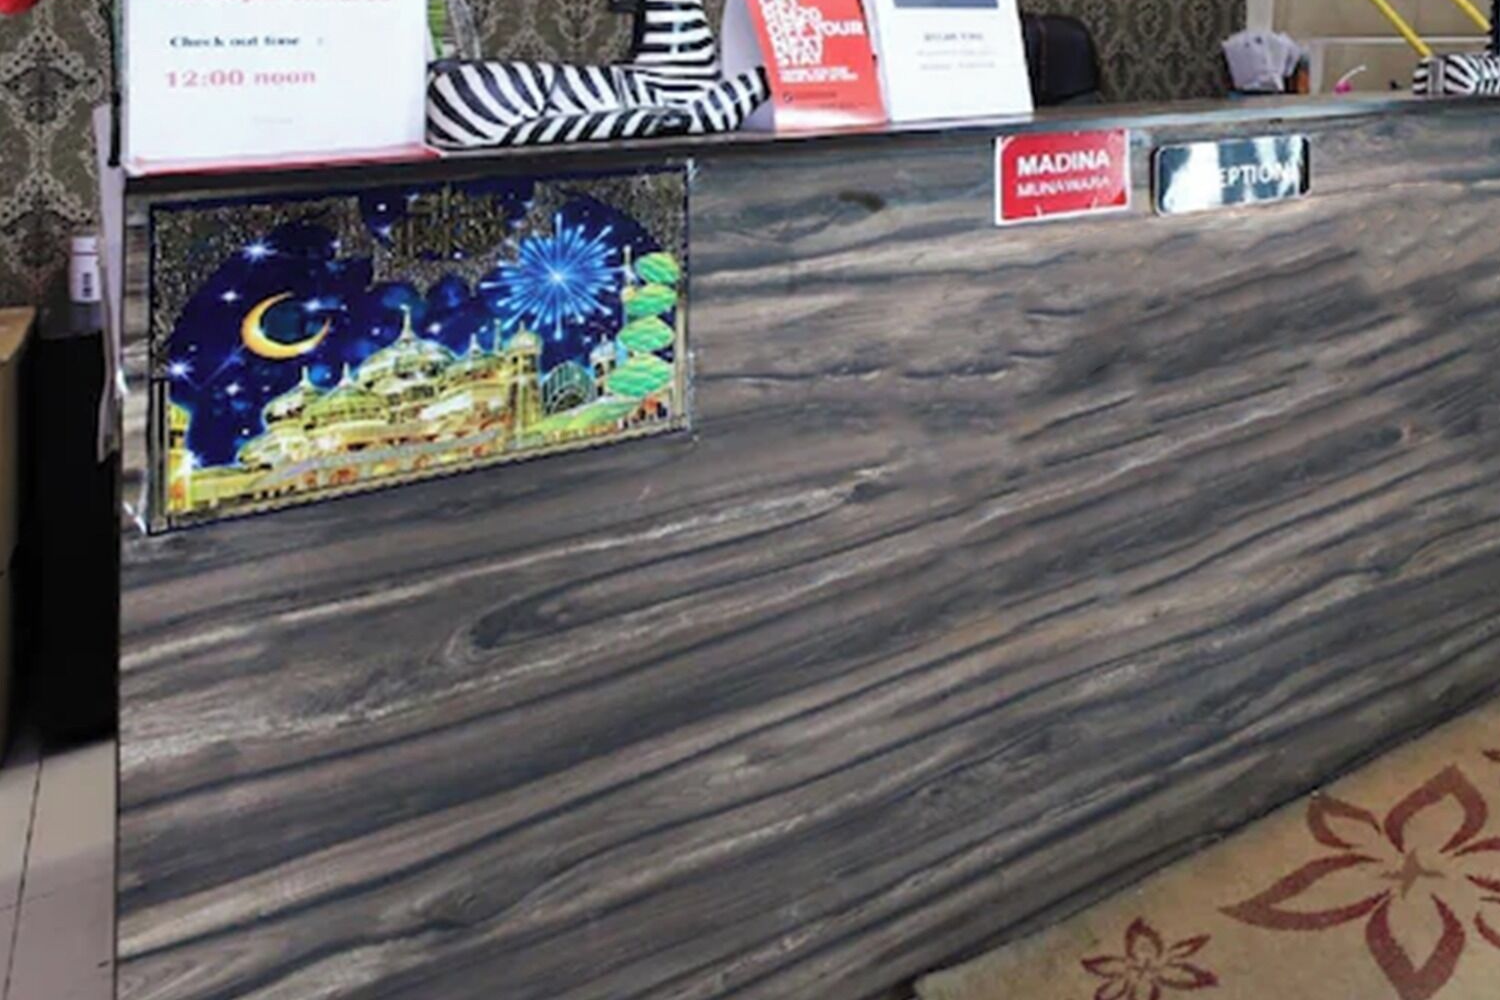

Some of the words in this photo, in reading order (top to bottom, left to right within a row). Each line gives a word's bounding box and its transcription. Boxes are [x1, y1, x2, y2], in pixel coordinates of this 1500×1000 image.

[169, 35, 225, 48] Check
[165, 69, 246, 88] 12:00
[253, 70, 317, 86] noon
[1016, 148, 1111, 177] MADINA
